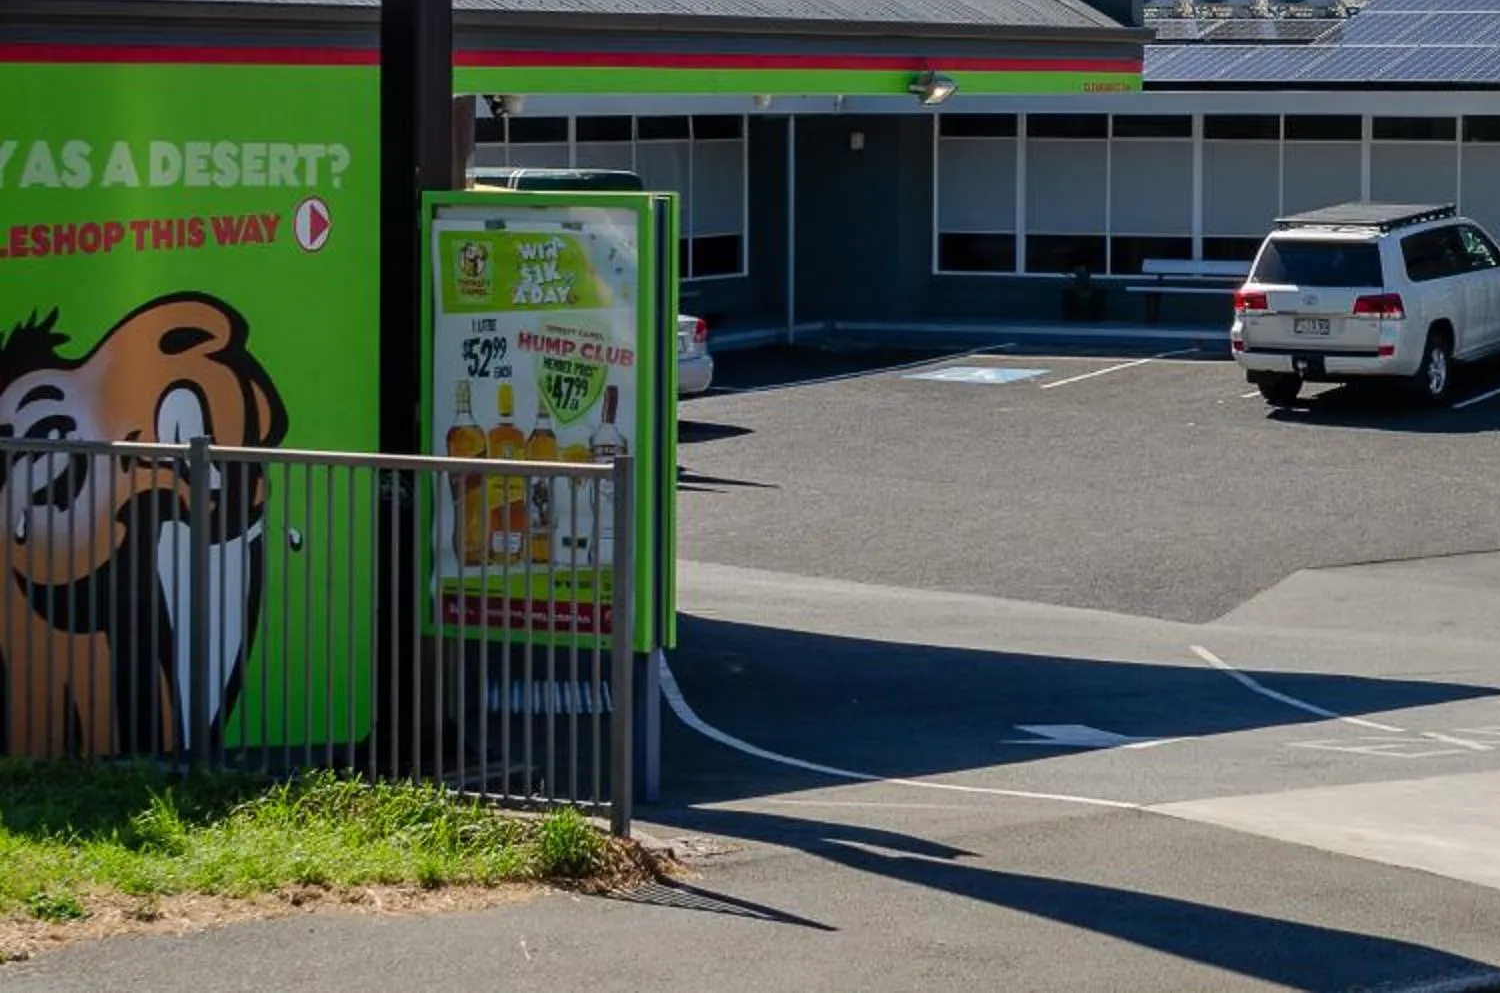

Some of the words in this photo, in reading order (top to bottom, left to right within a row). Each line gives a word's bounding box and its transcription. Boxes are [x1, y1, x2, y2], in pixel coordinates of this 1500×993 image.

[19, 140, 94, 189] AS
[101, 140, 140, 188] A
[147, 139, 350, 189] DESERT?
[0, 221, 125, 258] ESHOP
[129, 217, 206, 252] THIS
[210, 214, 282, 247] WAY
[530, 286, 571, 304] DAY
[517, 330, 577, 356] HUMP
[579, 342, 635, 367] CLUB
